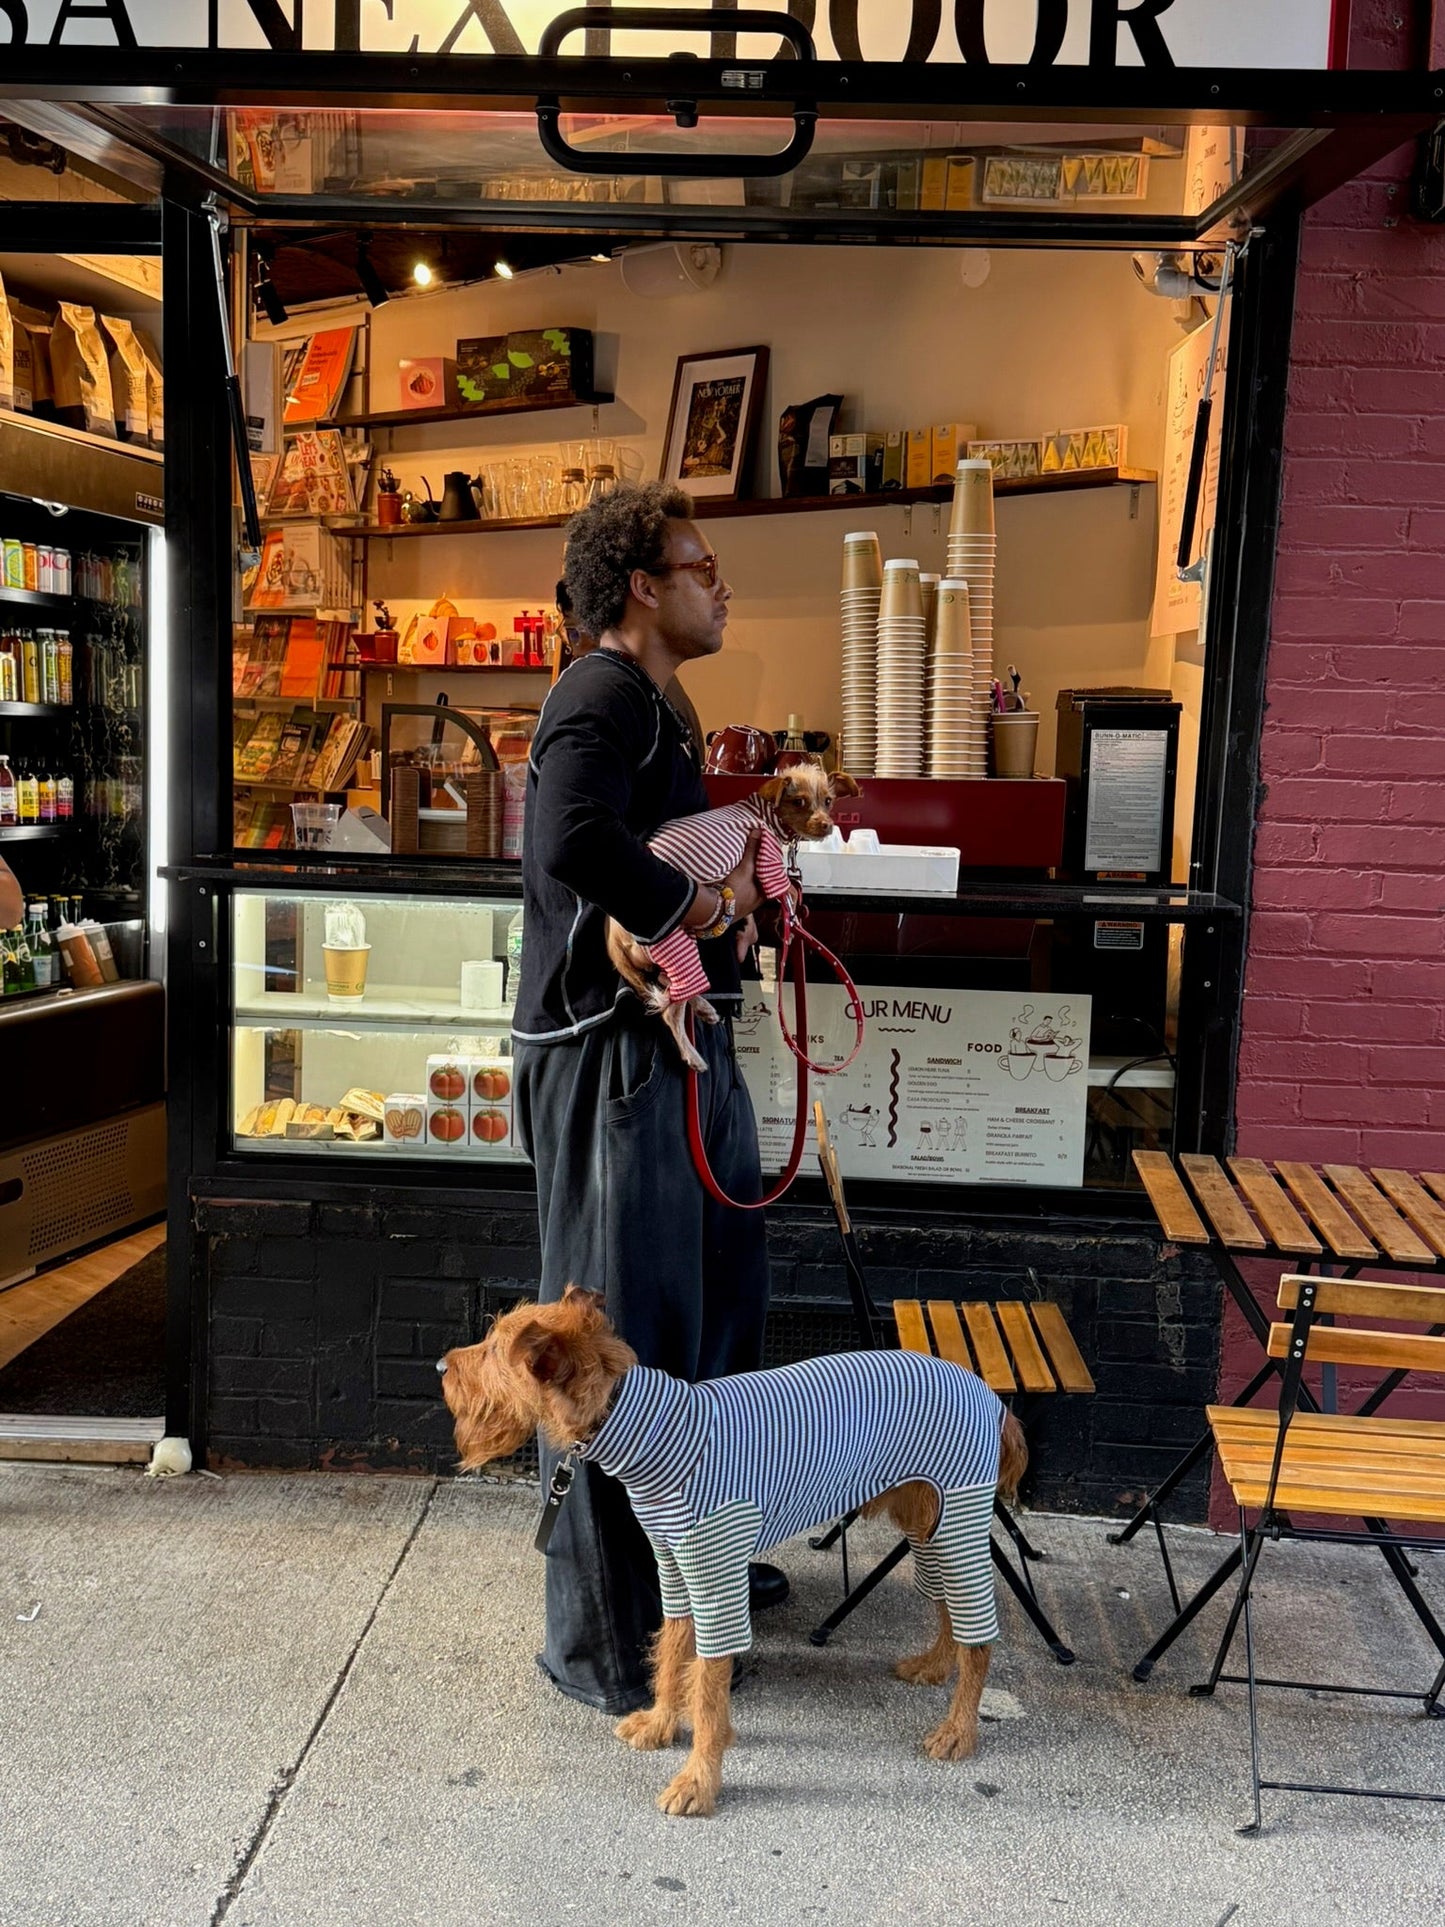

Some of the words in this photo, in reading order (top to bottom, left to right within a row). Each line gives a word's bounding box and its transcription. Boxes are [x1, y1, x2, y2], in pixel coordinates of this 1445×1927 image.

[0, 0, 139, 47] A
[845, 1000, 889, 1021] OUR
[892, 1001, 952, 1024] MENU
[737, 1046, 760, 1054] COFFEE
[967, 1042, 1002, 1054] FOOD
[927, 1057, 963, 1066] SANDWICH
[1015, 1107, 1050, 1115] BREAKFAST
